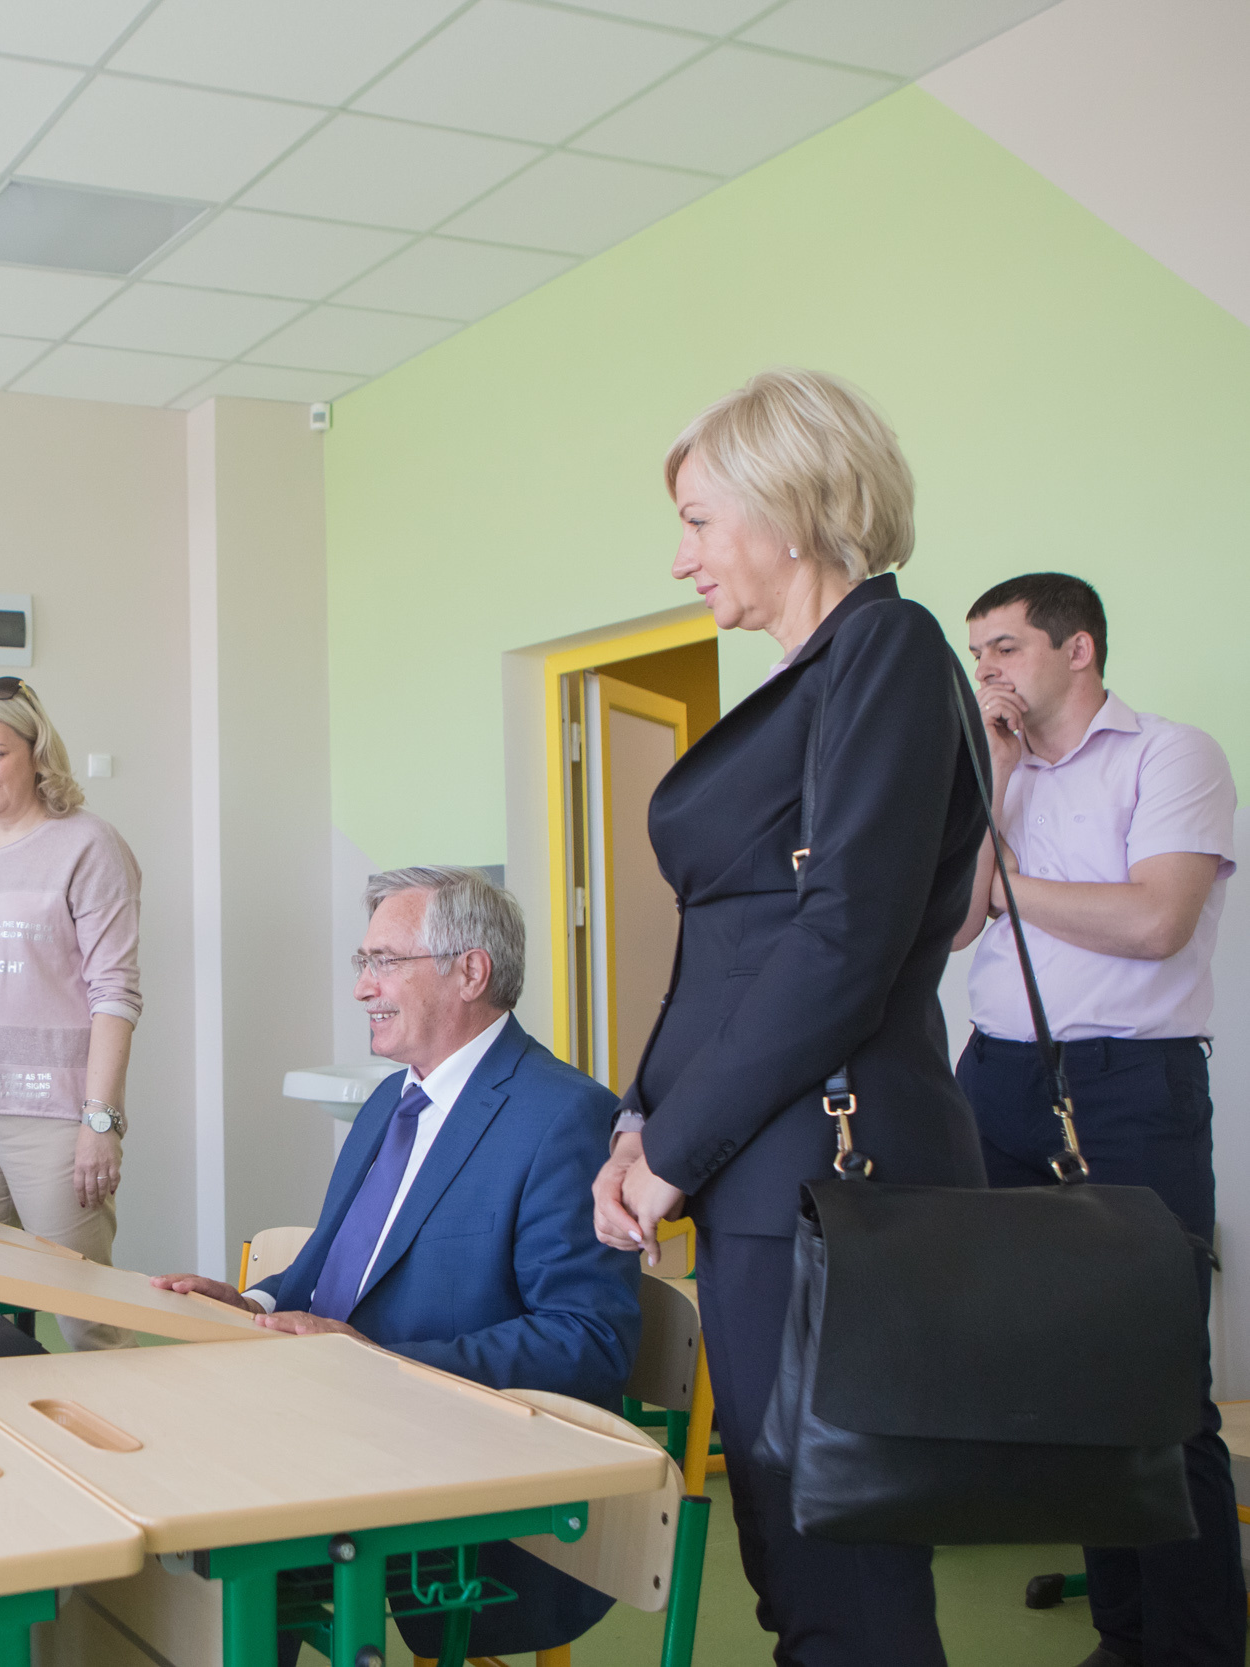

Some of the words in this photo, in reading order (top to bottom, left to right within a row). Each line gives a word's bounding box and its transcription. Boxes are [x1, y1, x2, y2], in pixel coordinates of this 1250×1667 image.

[2, 920, 15, 928] THE
[25, 1073, 36, 1081] AS
[37, 1072, 52, 1080] THE
[26, 1082, 51, 1090] SIGNS
